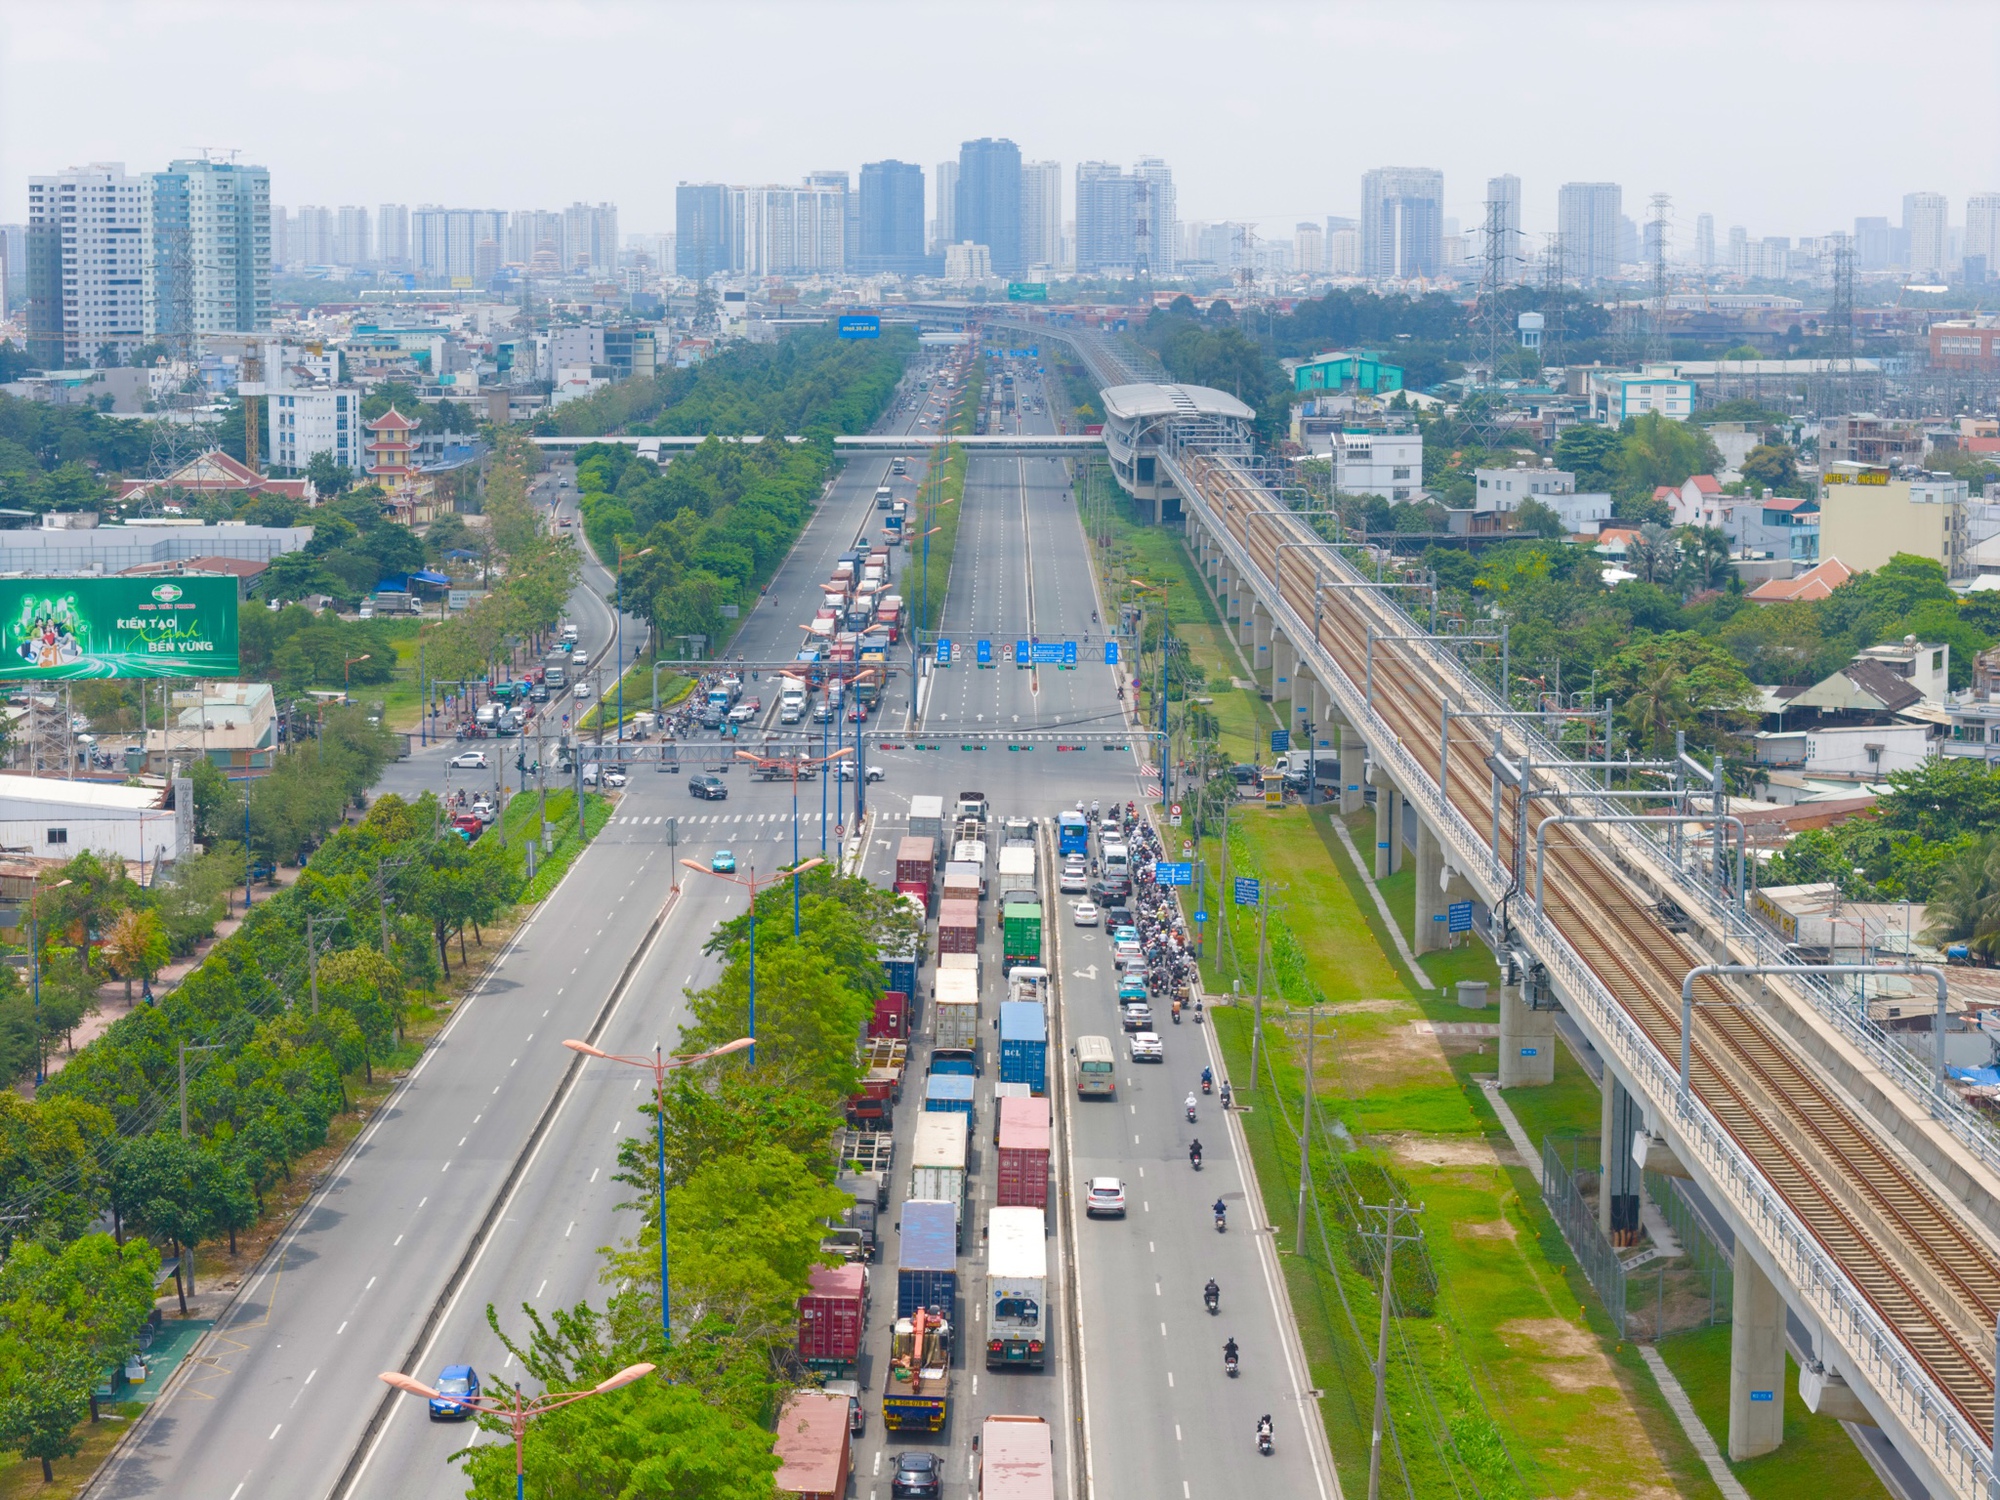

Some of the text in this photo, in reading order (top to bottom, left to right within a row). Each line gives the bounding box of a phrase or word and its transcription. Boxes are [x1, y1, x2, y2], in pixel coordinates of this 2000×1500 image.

[1824, 473, 1843, 484] HOTEL
[117, 616, 175, 630] KIẾN TẠO
[126, 615, 203, 651] Xanh
